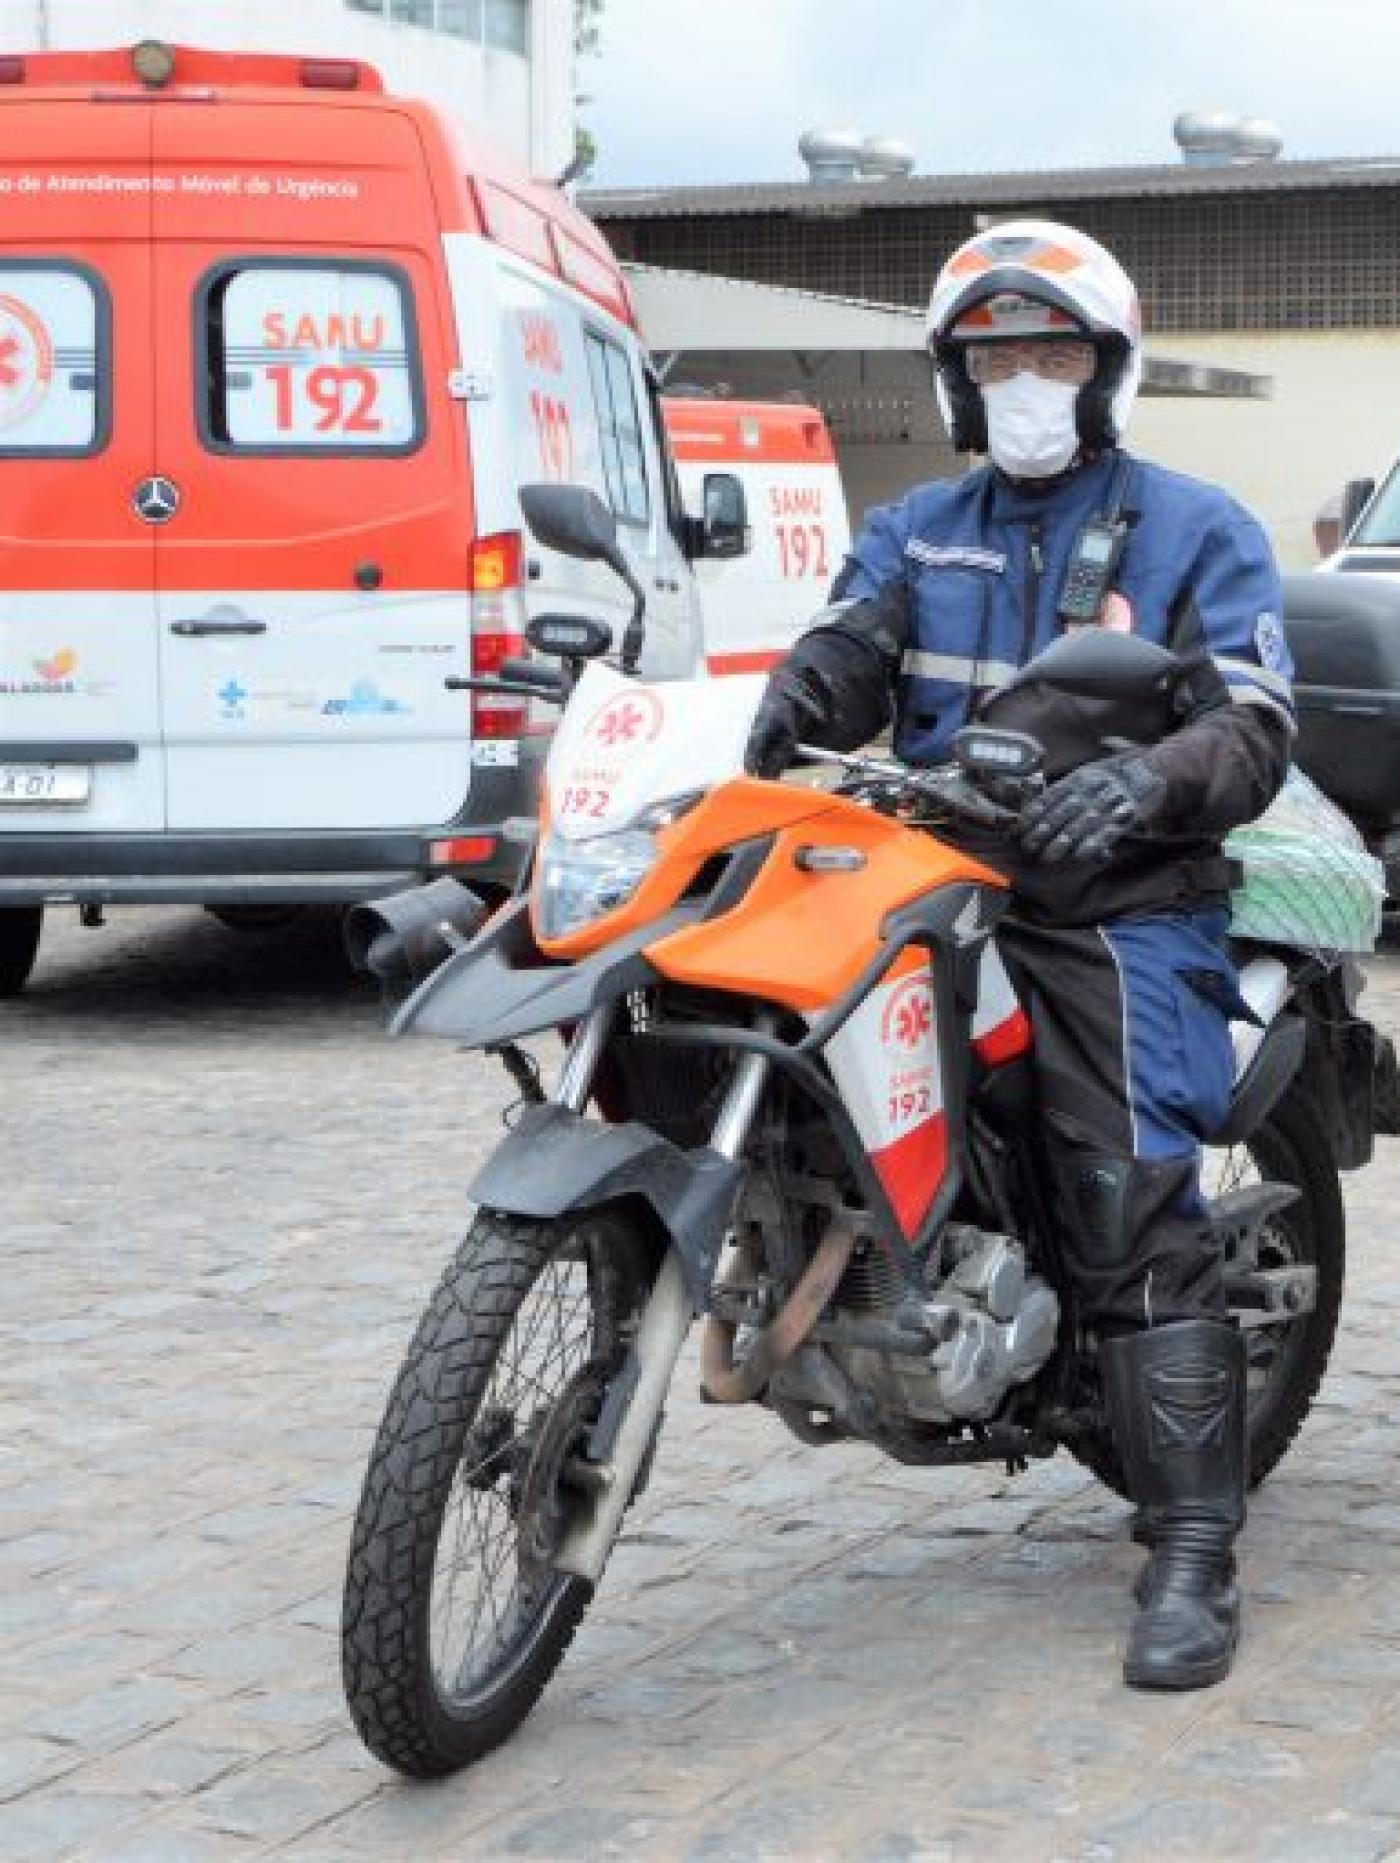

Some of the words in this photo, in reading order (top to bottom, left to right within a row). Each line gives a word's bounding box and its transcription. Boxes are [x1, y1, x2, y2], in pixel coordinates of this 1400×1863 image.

[18, 174, 40, 191] de
[47, 174, 175, 191] Atendimento
[263, 311, 383, 350] SAMU
[263, 364, 382, 431] 192
[769, 487, 823, 516] SAMU
[775, 523, 828, 577] 192
[561, 787, 611, 818] 192
[889, 1087, 930, 1122] 192
